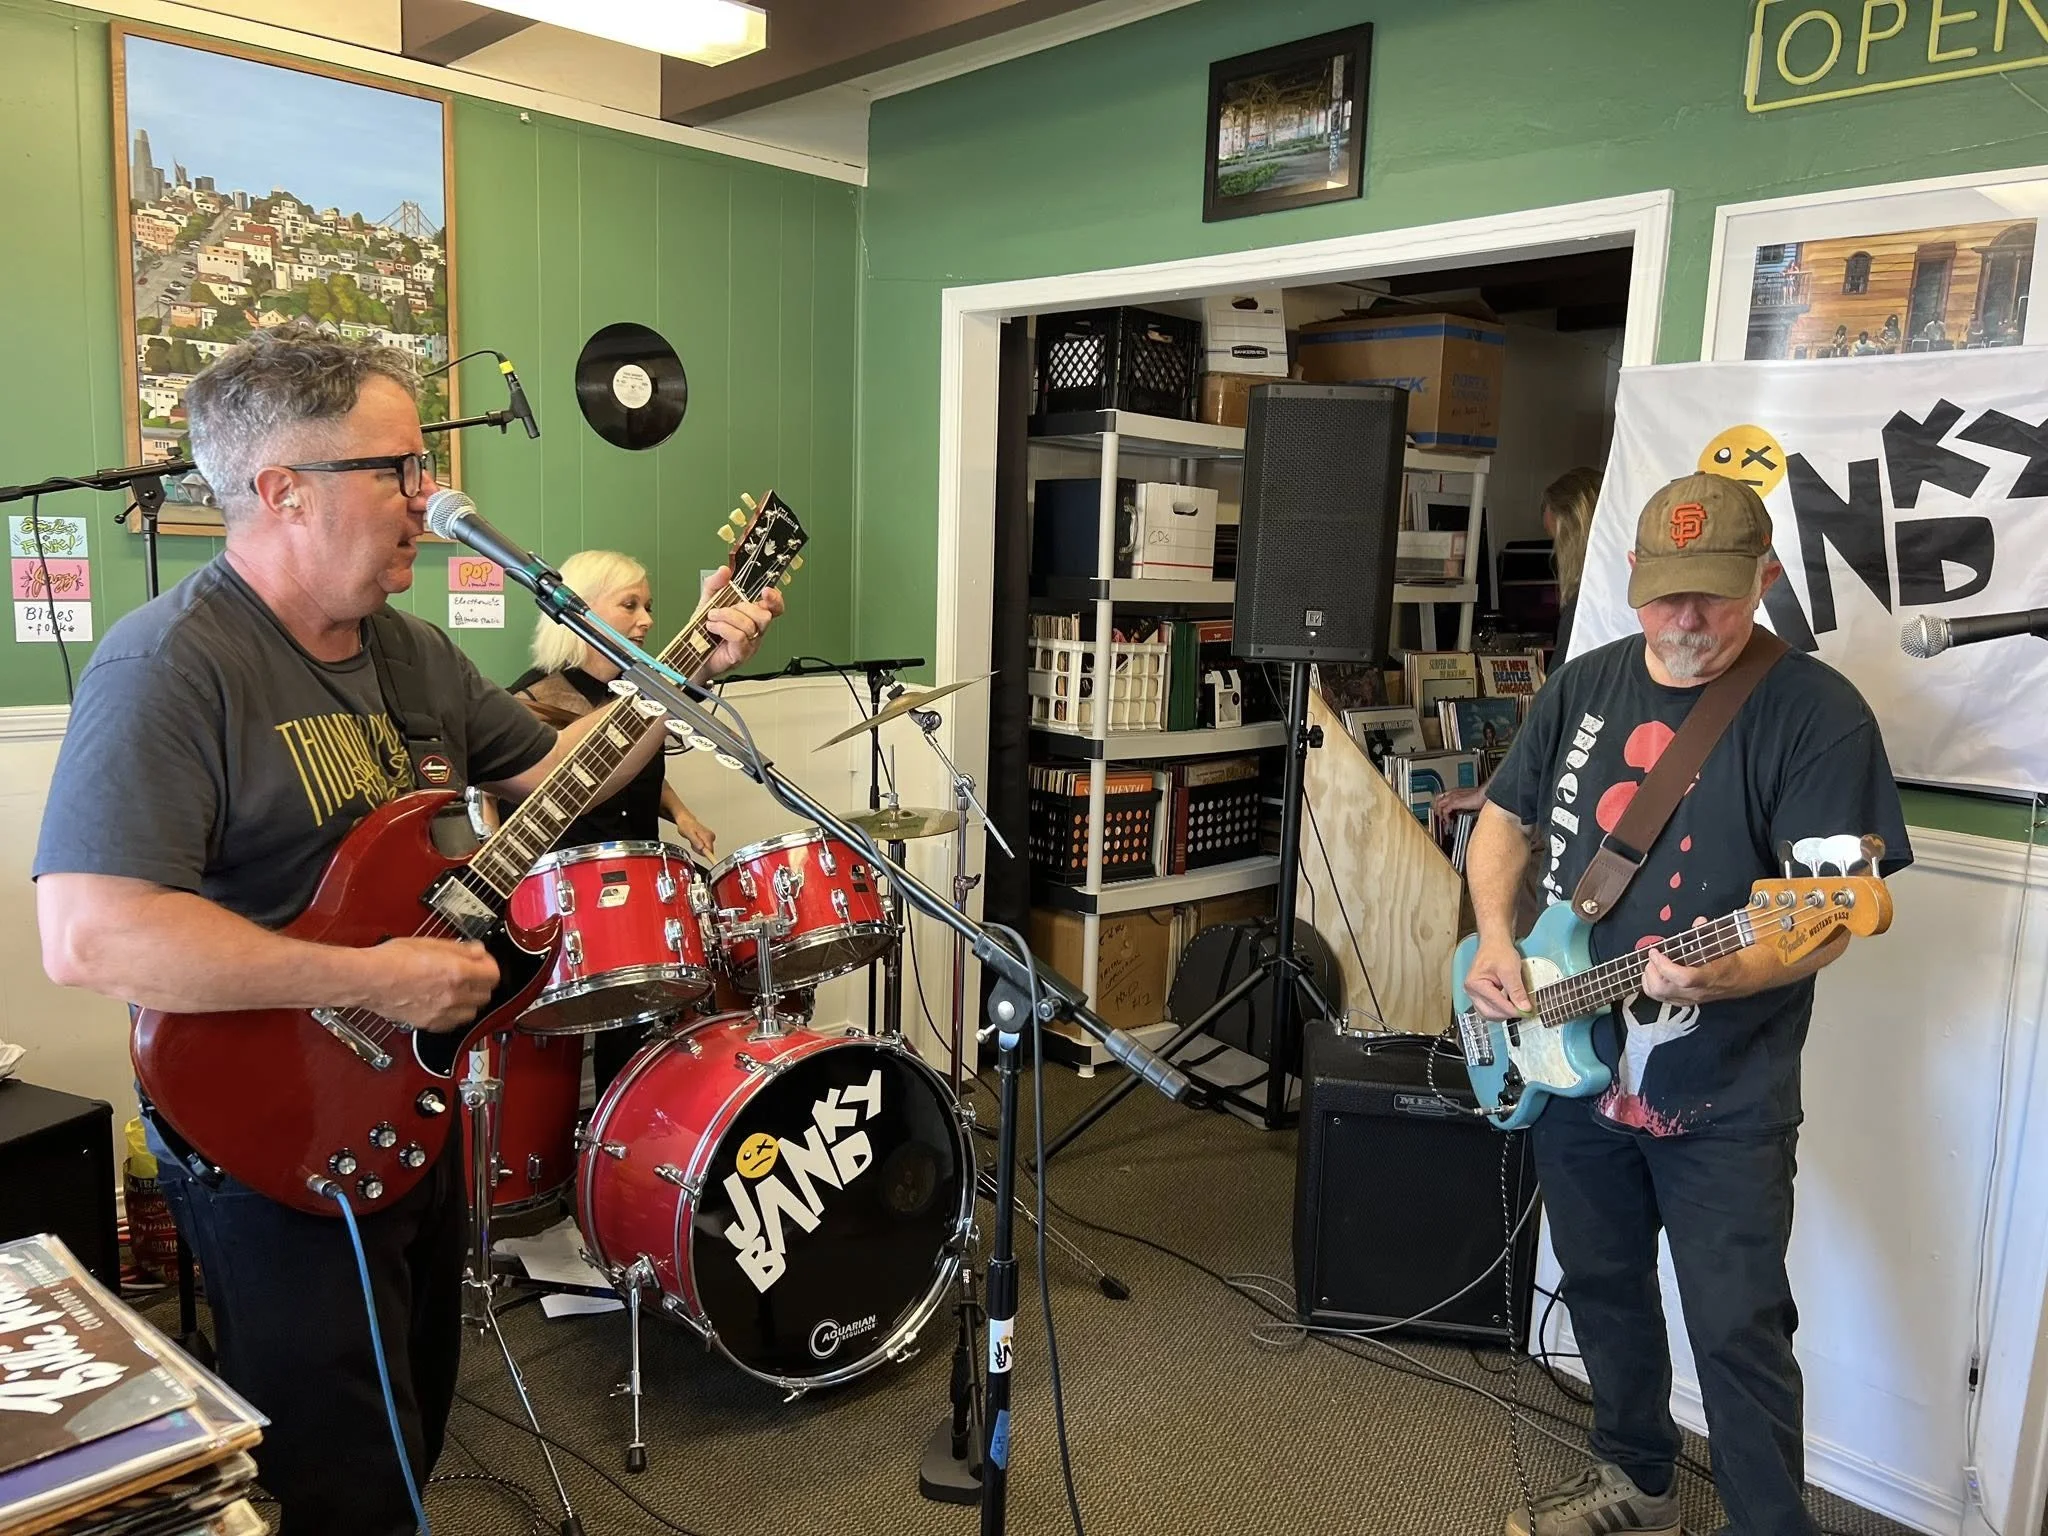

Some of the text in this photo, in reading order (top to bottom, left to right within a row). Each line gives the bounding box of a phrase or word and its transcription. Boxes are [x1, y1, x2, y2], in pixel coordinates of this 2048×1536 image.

[1148, 530, 1169, 545] CDs
[1670, 502, 1707, 549] SF
[459, 561, 493, 587] POP
[821, 1314, 877, 1344] AQUARIAN
